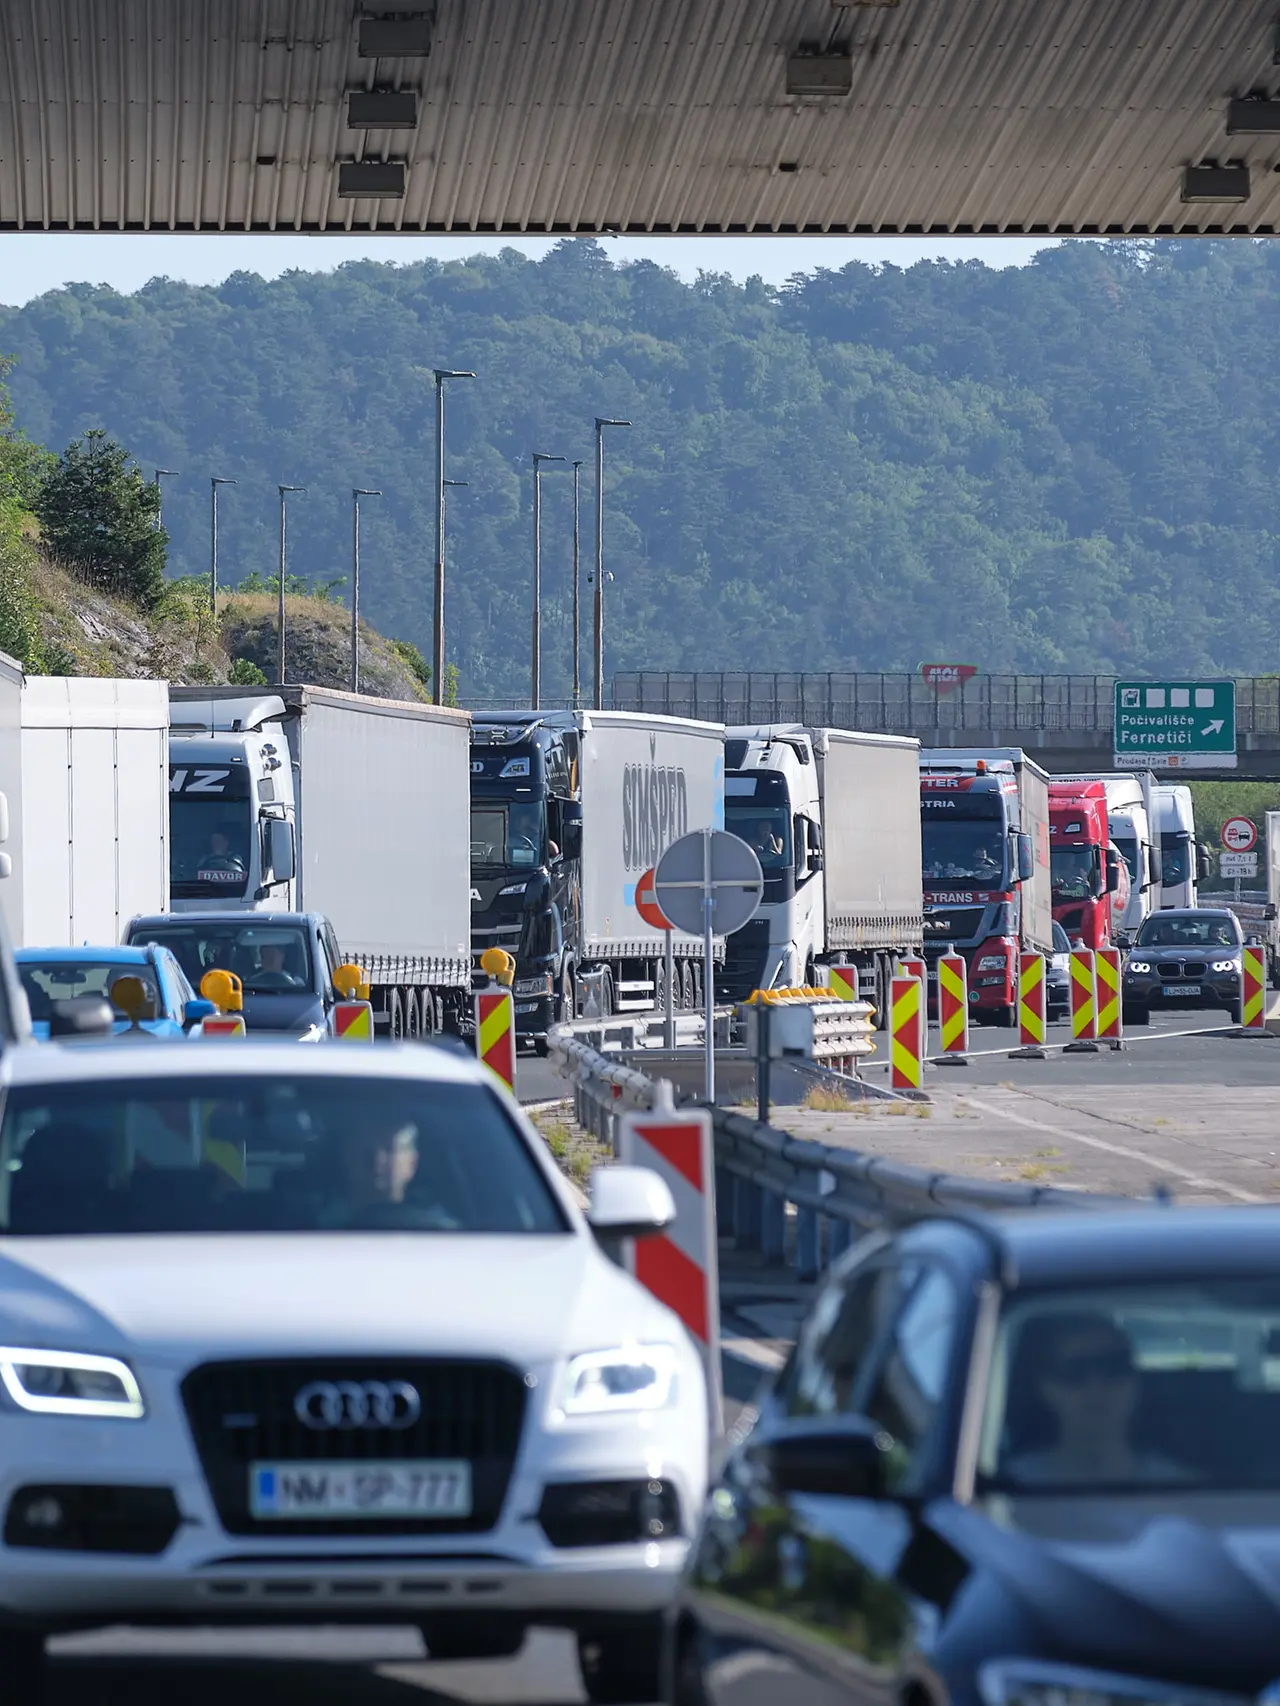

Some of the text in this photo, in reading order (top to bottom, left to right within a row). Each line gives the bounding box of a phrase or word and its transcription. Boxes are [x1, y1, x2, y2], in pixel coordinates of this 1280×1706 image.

[1121, 714, 1195, 726] Počivališče
[1121, 730, 1192, 744] Fernetiči
[203, 872, 243, 881] DAVOR
